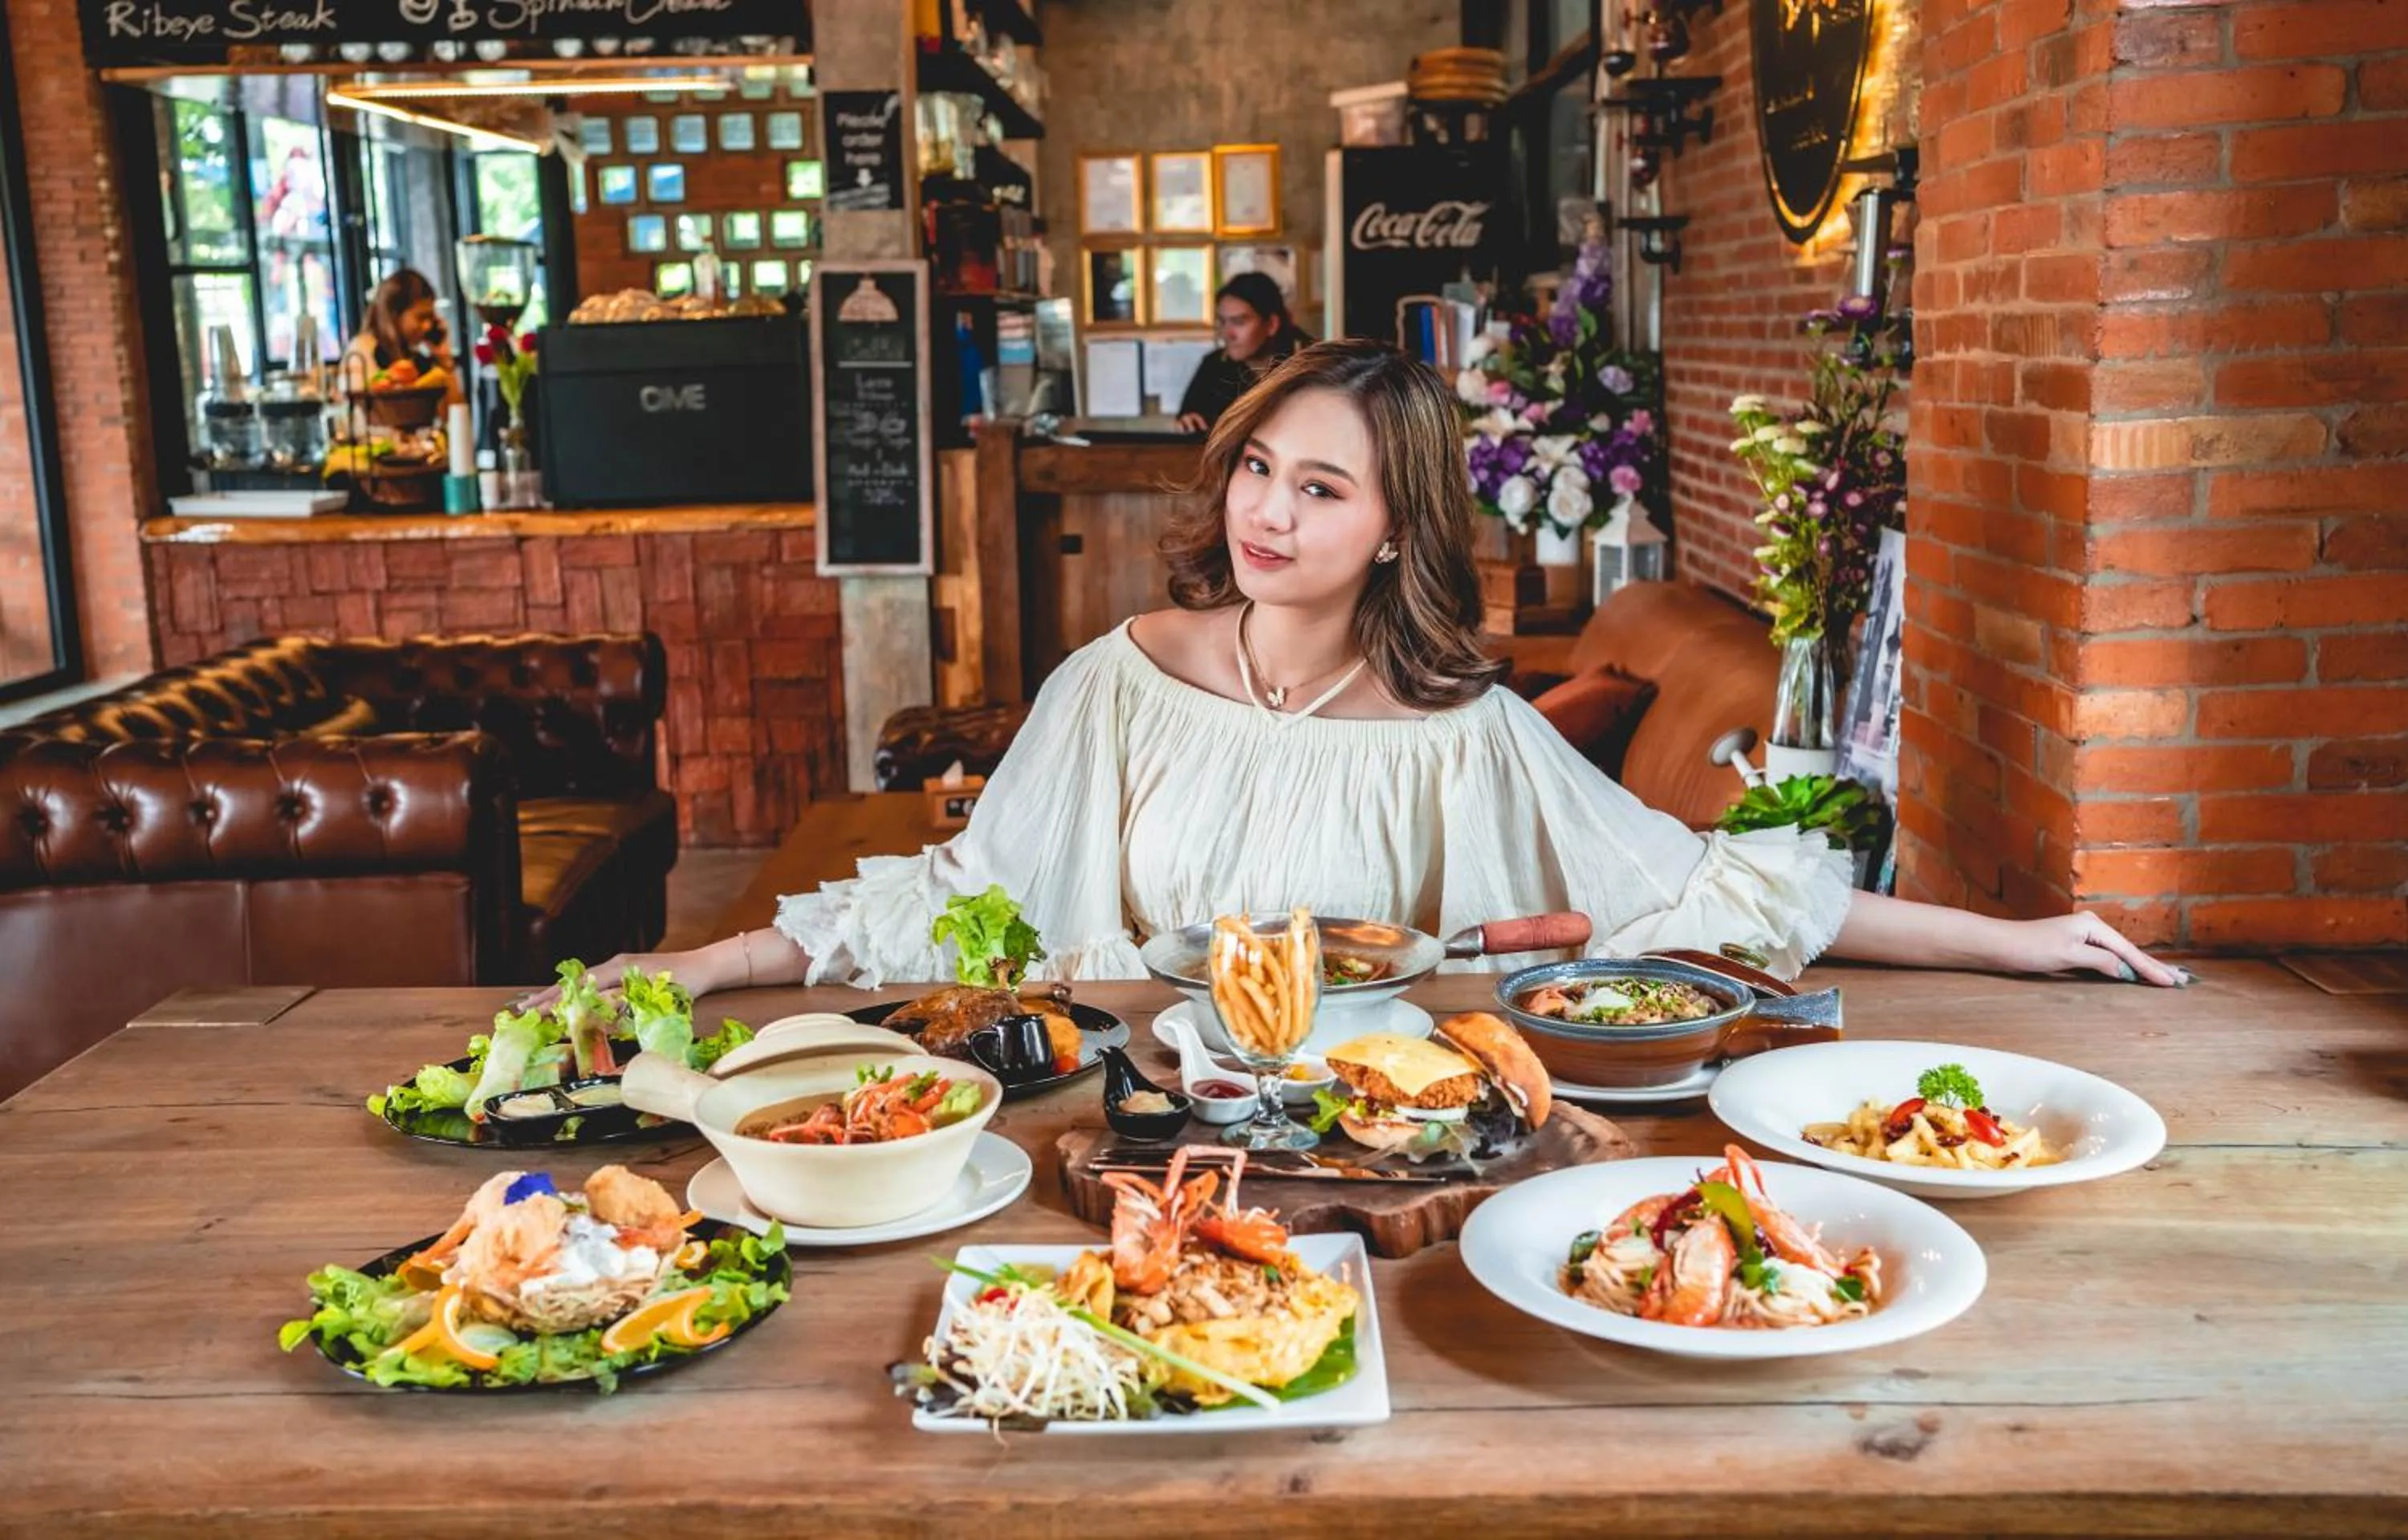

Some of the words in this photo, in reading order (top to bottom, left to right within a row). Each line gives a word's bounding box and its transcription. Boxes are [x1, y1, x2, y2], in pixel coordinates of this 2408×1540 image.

[104, 0, 215, 40] Ribeye
[222, 0, 337, 39] Steak
[1351, 201, 1490, 250] Coca-Cola
